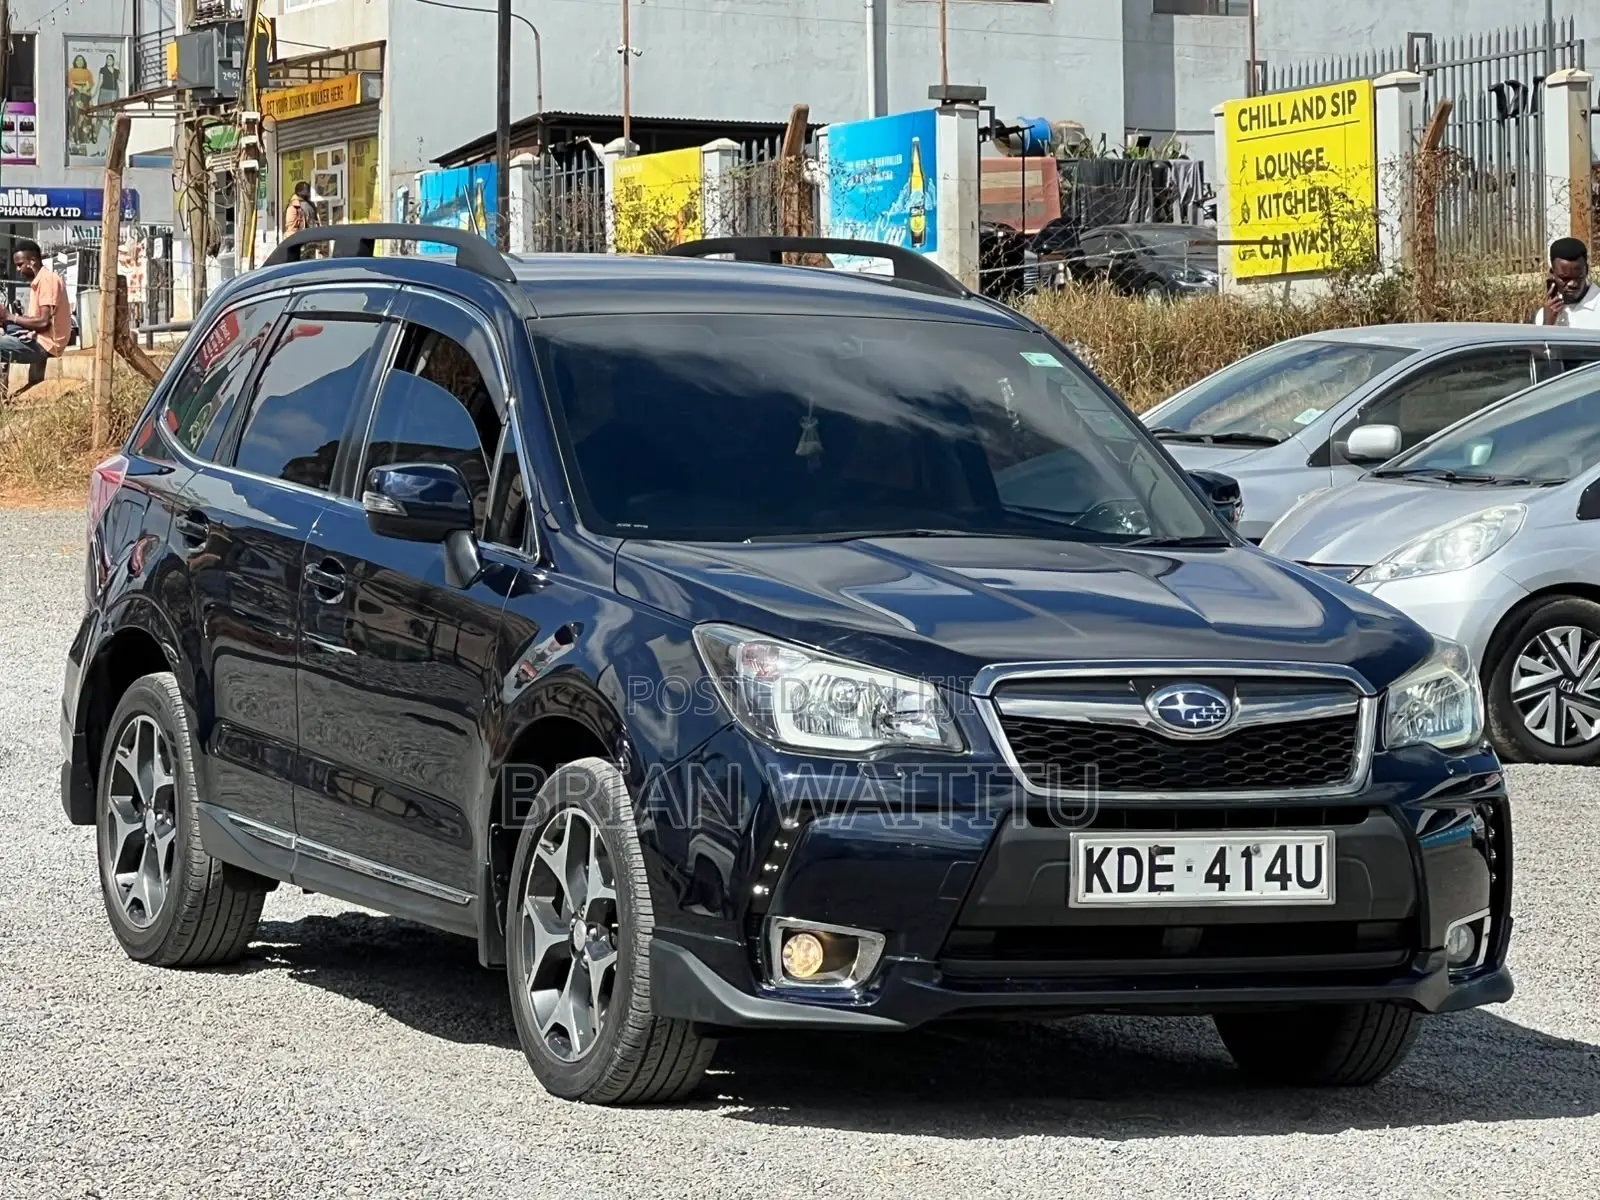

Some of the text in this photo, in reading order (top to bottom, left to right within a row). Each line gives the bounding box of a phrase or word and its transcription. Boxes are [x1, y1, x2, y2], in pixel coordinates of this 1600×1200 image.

[1237, 89, 1358, 132] CHILL AND SIP
[1255, 147, 1326, 181] LOUNGE
[0, 206, 59, 217] PHARMACY
[60, 207, 81, 217] LTD
[1257, 185, 1331, 221] KITCHEN
[1085, 844, 1323, 893] KDE 414U
